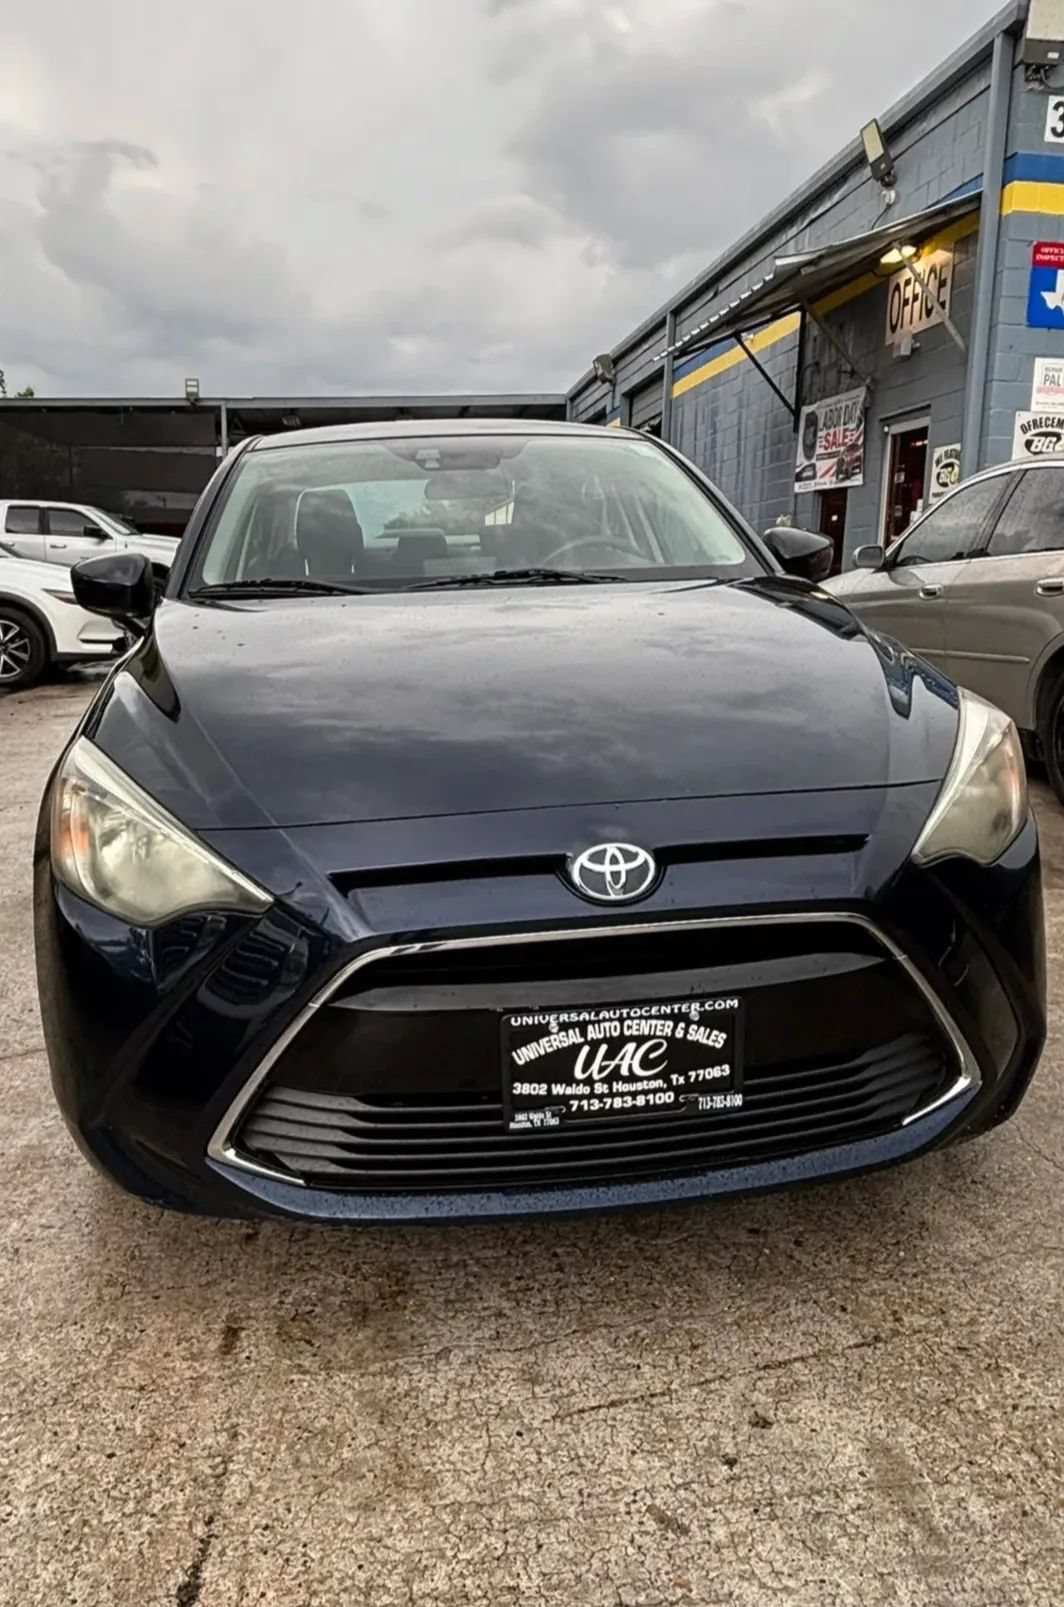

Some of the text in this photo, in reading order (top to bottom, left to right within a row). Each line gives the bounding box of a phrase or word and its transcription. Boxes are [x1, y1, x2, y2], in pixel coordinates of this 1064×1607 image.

[889, 263, 948, 334] OFFICE
[823, 428, 849, 451] SALE
[510, 998, 740, 1026] UNIVERSALAUTOCENTER.COM
[511, 1019, 727, 1066] UNIVERSAL AUTO CENTER & SALES
[574, 1038, 668, 1080] UAC
[512, 1063, 730, 1095] 3802 Waldo St Houston, Tx 77063
[569, 1091, 675, 1112] 713-783-8100
